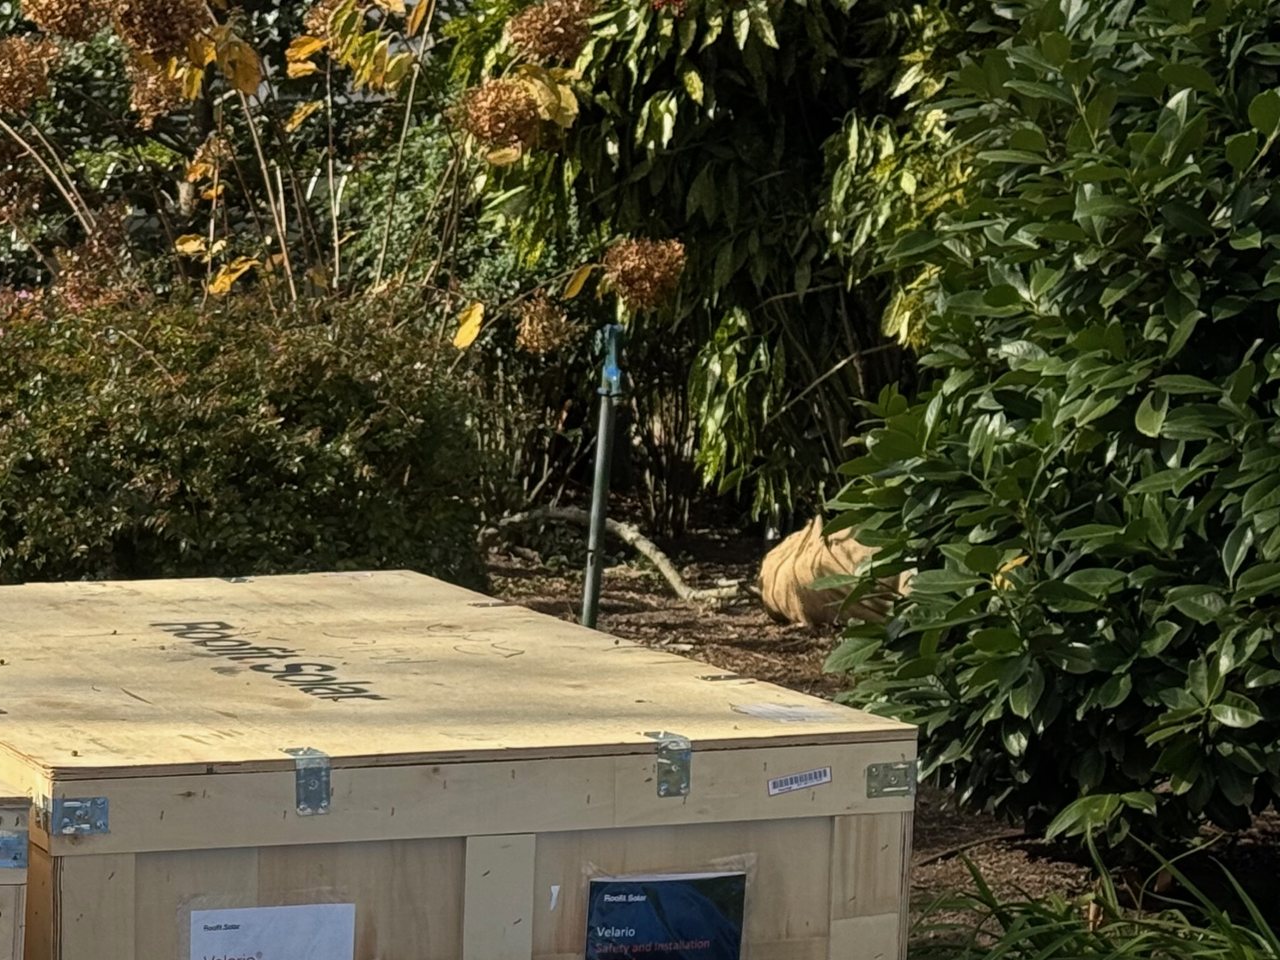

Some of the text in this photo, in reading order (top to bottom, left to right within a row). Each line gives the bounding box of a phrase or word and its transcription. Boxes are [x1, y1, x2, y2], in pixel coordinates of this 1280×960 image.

[150, 621, 307, 660] Roofit
[249, 662, 391, 700] Solar
[596, 926, 636, 937] Velario
[595, 939, 711, 955] Safety and Installation
